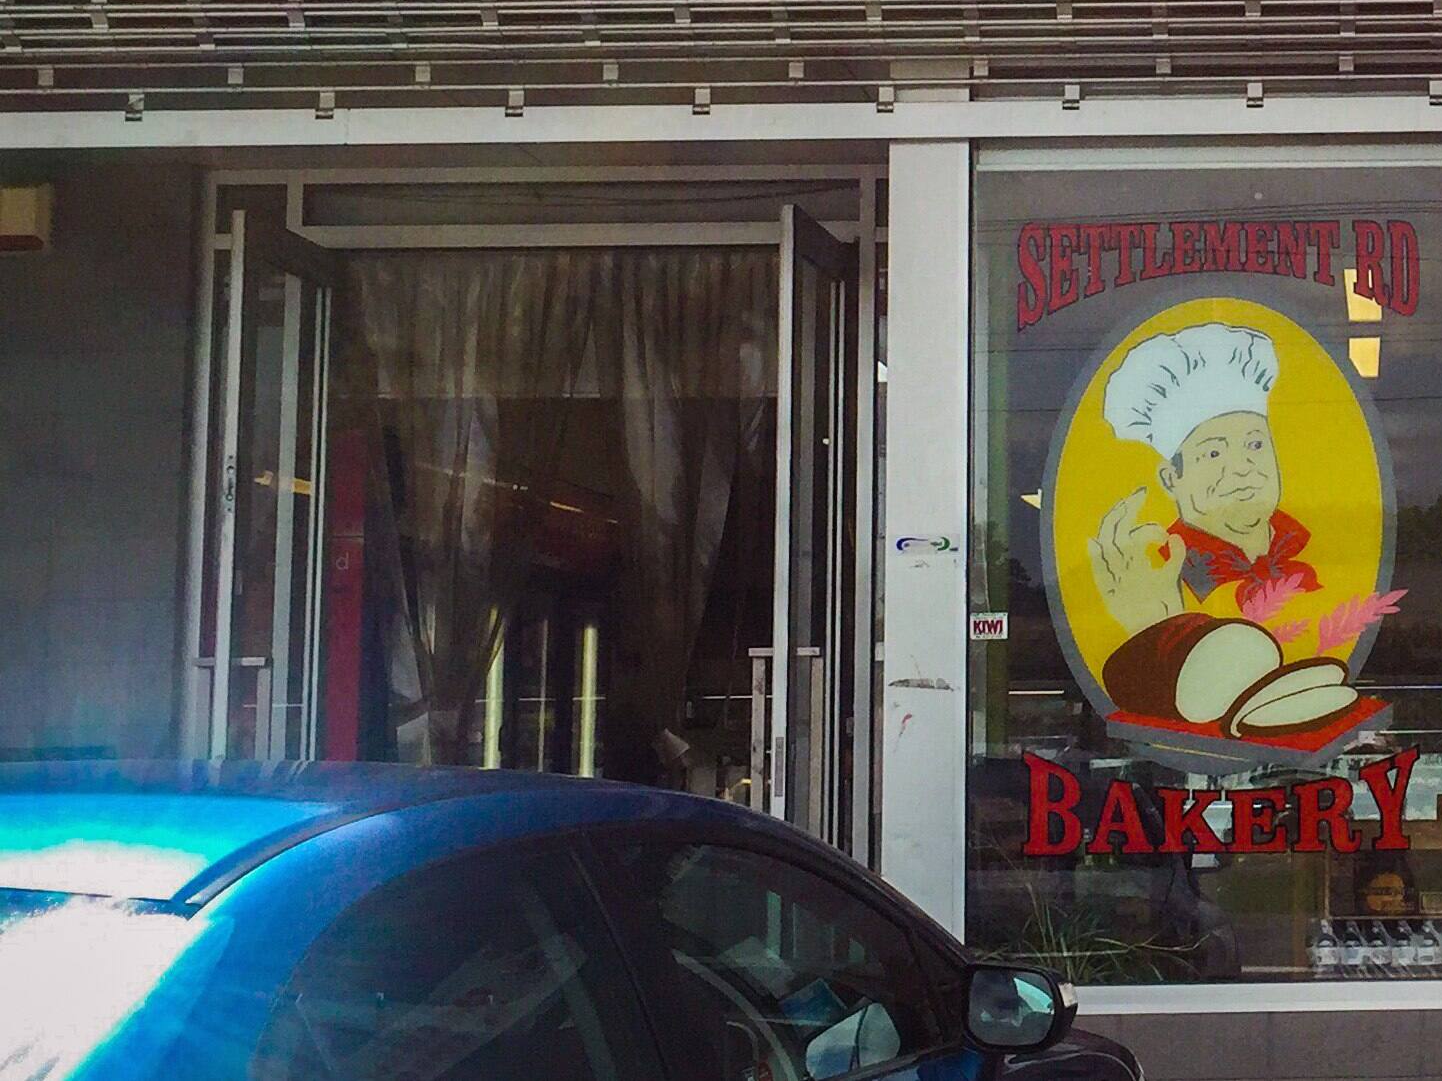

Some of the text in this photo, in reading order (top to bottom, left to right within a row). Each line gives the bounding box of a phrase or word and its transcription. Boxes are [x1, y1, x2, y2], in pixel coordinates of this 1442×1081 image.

[1017, 219, 1421, 333] SETTLEMENT RD
[1021, 744, 1421, 857] BAKERY
